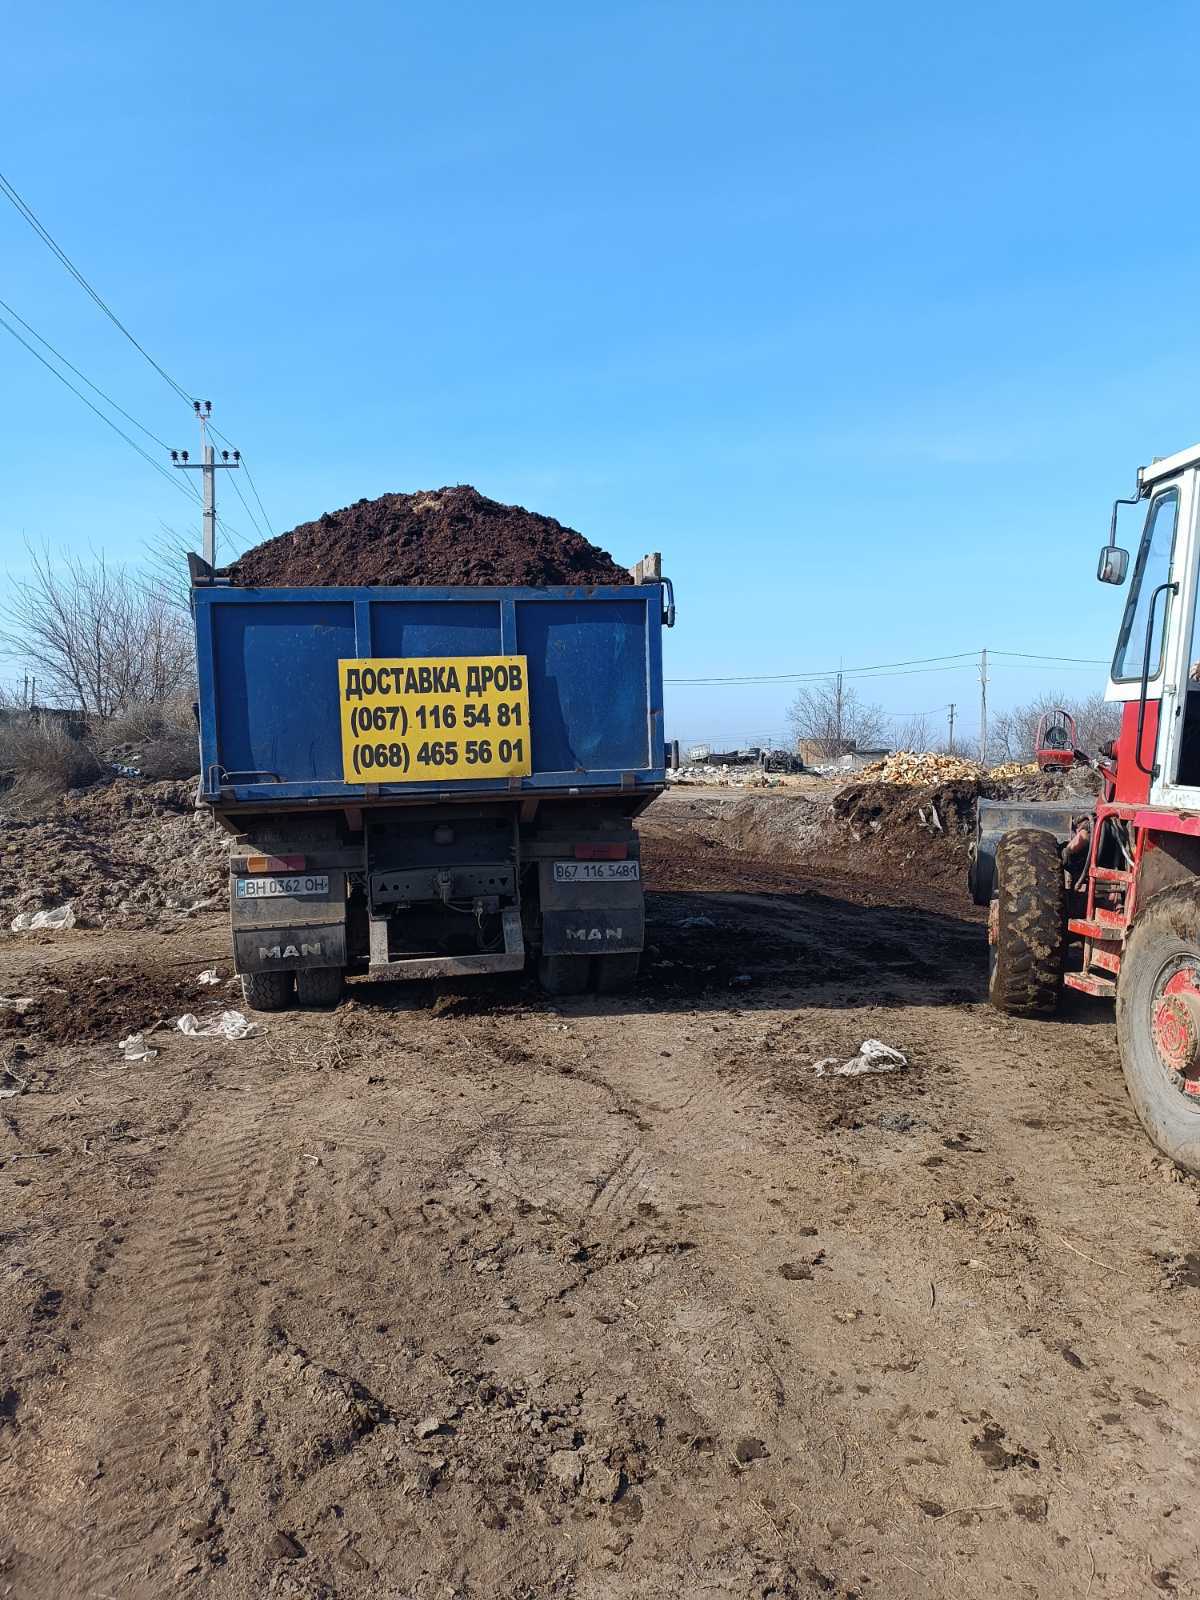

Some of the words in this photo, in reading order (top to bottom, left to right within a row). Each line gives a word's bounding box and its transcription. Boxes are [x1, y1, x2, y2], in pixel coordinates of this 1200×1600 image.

[346, 667, 461, 701] ДОСТАВКА
[465, 665, 522, 697] ДРОВ
[351, 706, 408, 738] (067)
[416, 704, 457, 729] 116
[463, 703, 491, 728] 54
[497, 702, 522, 727] 81
[353, 742, 410, 775] (068)
[417, 741, 458, 766] 465
[465, 739, 492, 764] 56
[499, 738, 523, 763] 01
[584, 865, 603, 877] 116
[246, 881, 266, 895] BH
[566, 927, 623, 941] MAN
[259, 943, 321, 959] MAN
